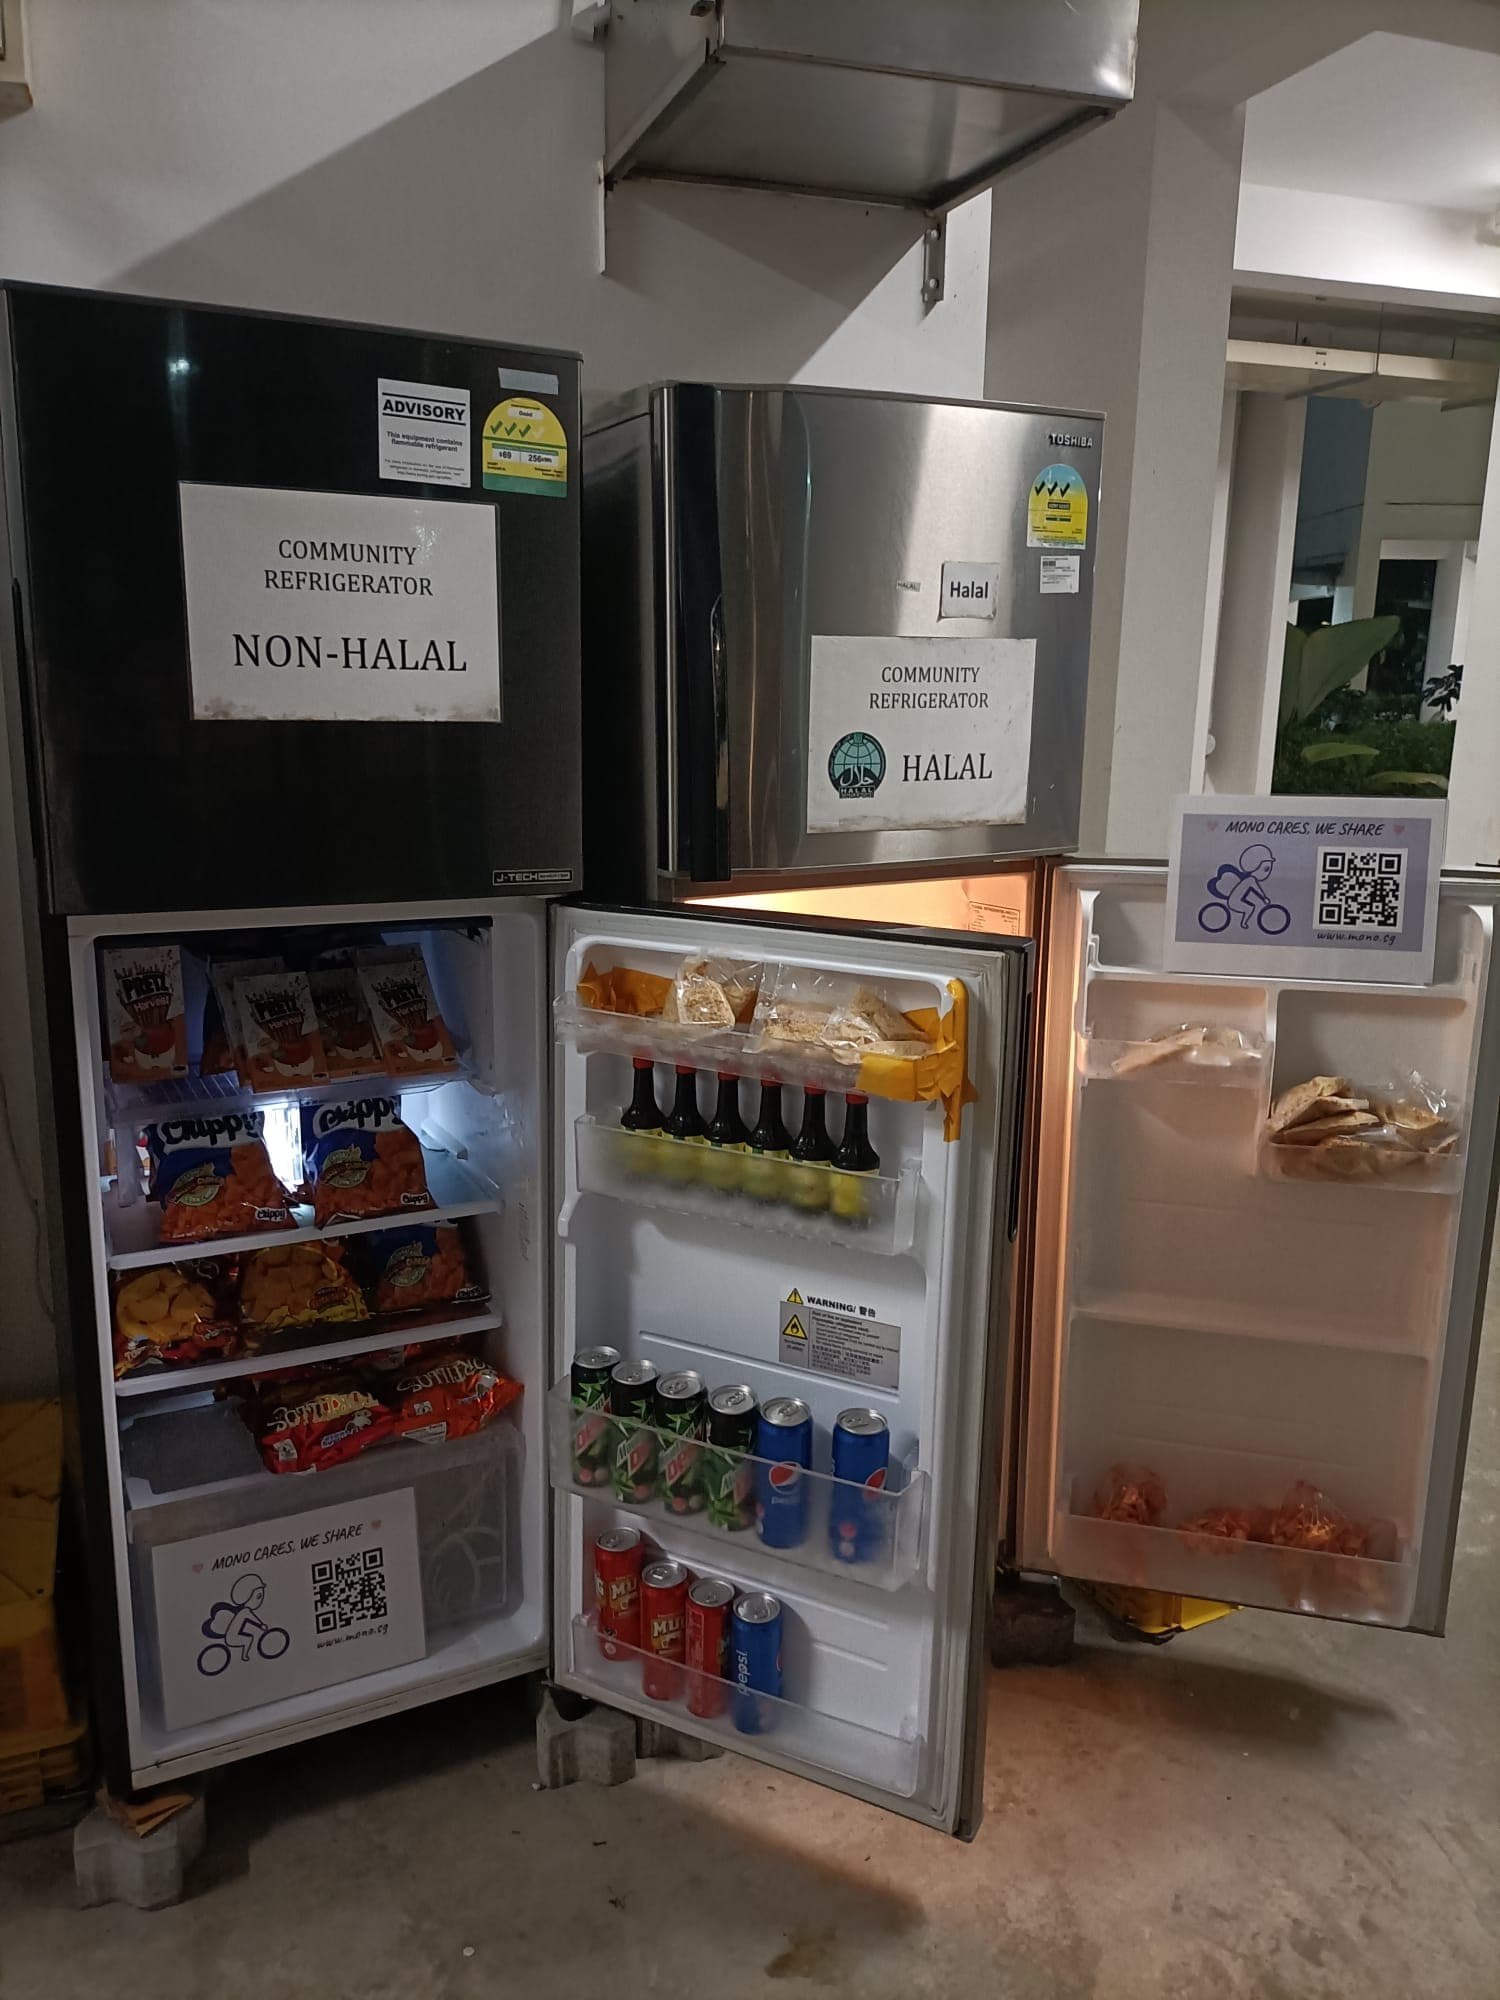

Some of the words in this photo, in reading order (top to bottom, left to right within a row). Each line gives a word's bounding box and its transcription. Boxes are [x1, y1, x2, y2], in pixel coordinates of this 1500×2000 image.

[382, 399, 466, 421] ADVISORY
[1051, 433, 1093, 447] TOSHIBA
[278, 539, 417, 565] COMMUNITY
[264, 569, 434, 596] REFRIGERATOR
[950, 581, 988, 599] Halal
[232, 633, 467, 672] NON-HALAL
[881, 667, 980, 683] COMMUNITY
[869, 692, 989, 709] REFRIGERATOR
[902, 752, 993, 782] HALAL
[1225, 820, 1264, 833] MONO
[1315, 823, 1338, 836] WE
[1338, 823, 1386, 836] SHARE
[211, 1551, 251, 1571] MONO
[299, 1534, 320, 1550] WE
[322, 1523, 365, 1545] SHARE
